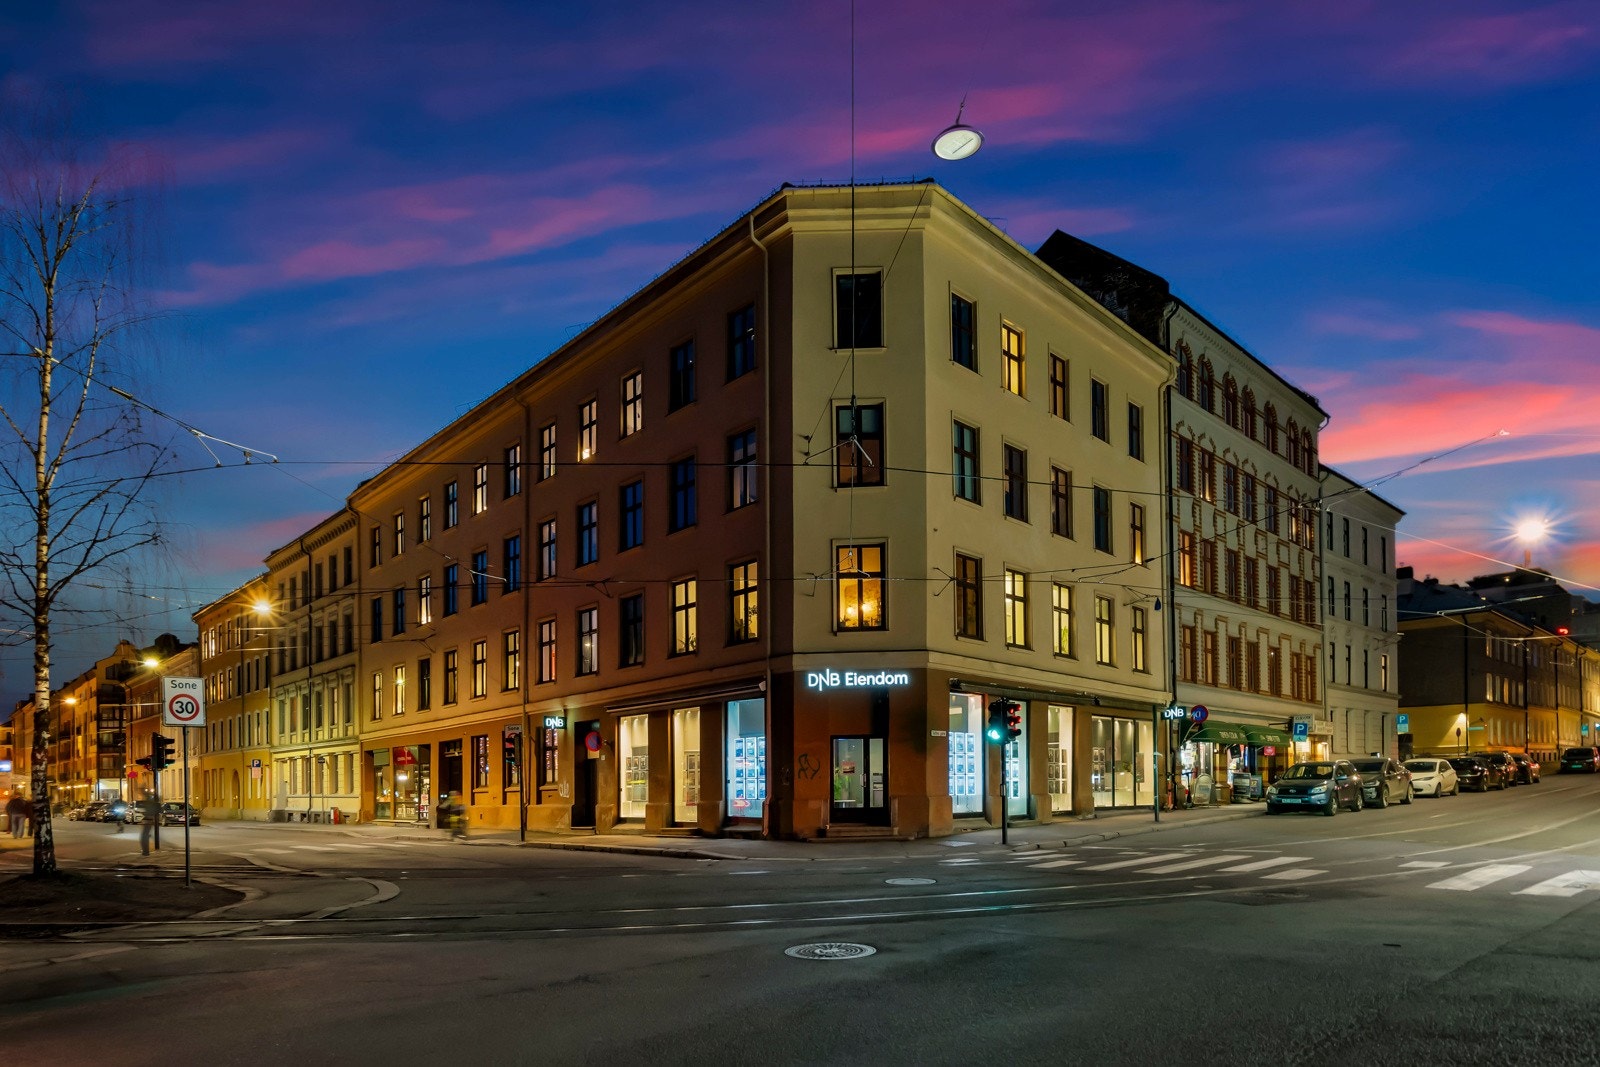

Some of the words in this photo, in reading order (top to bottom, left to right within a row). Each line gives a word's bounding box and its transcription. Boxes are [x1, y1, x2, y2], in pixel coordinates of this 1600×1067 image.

[170, 679, 198, 690] Sone
[807, 668, 841, 692] DNB
[845, 671, 909, 686] Eiendom
[175, 700, 195, 715] 30
[1164, 706, 1185, 720] DNB
[545, 716, 564, 729] DNB
[1399, 715, 1406, 724] P
[1296, 724, 1305, 734] P
